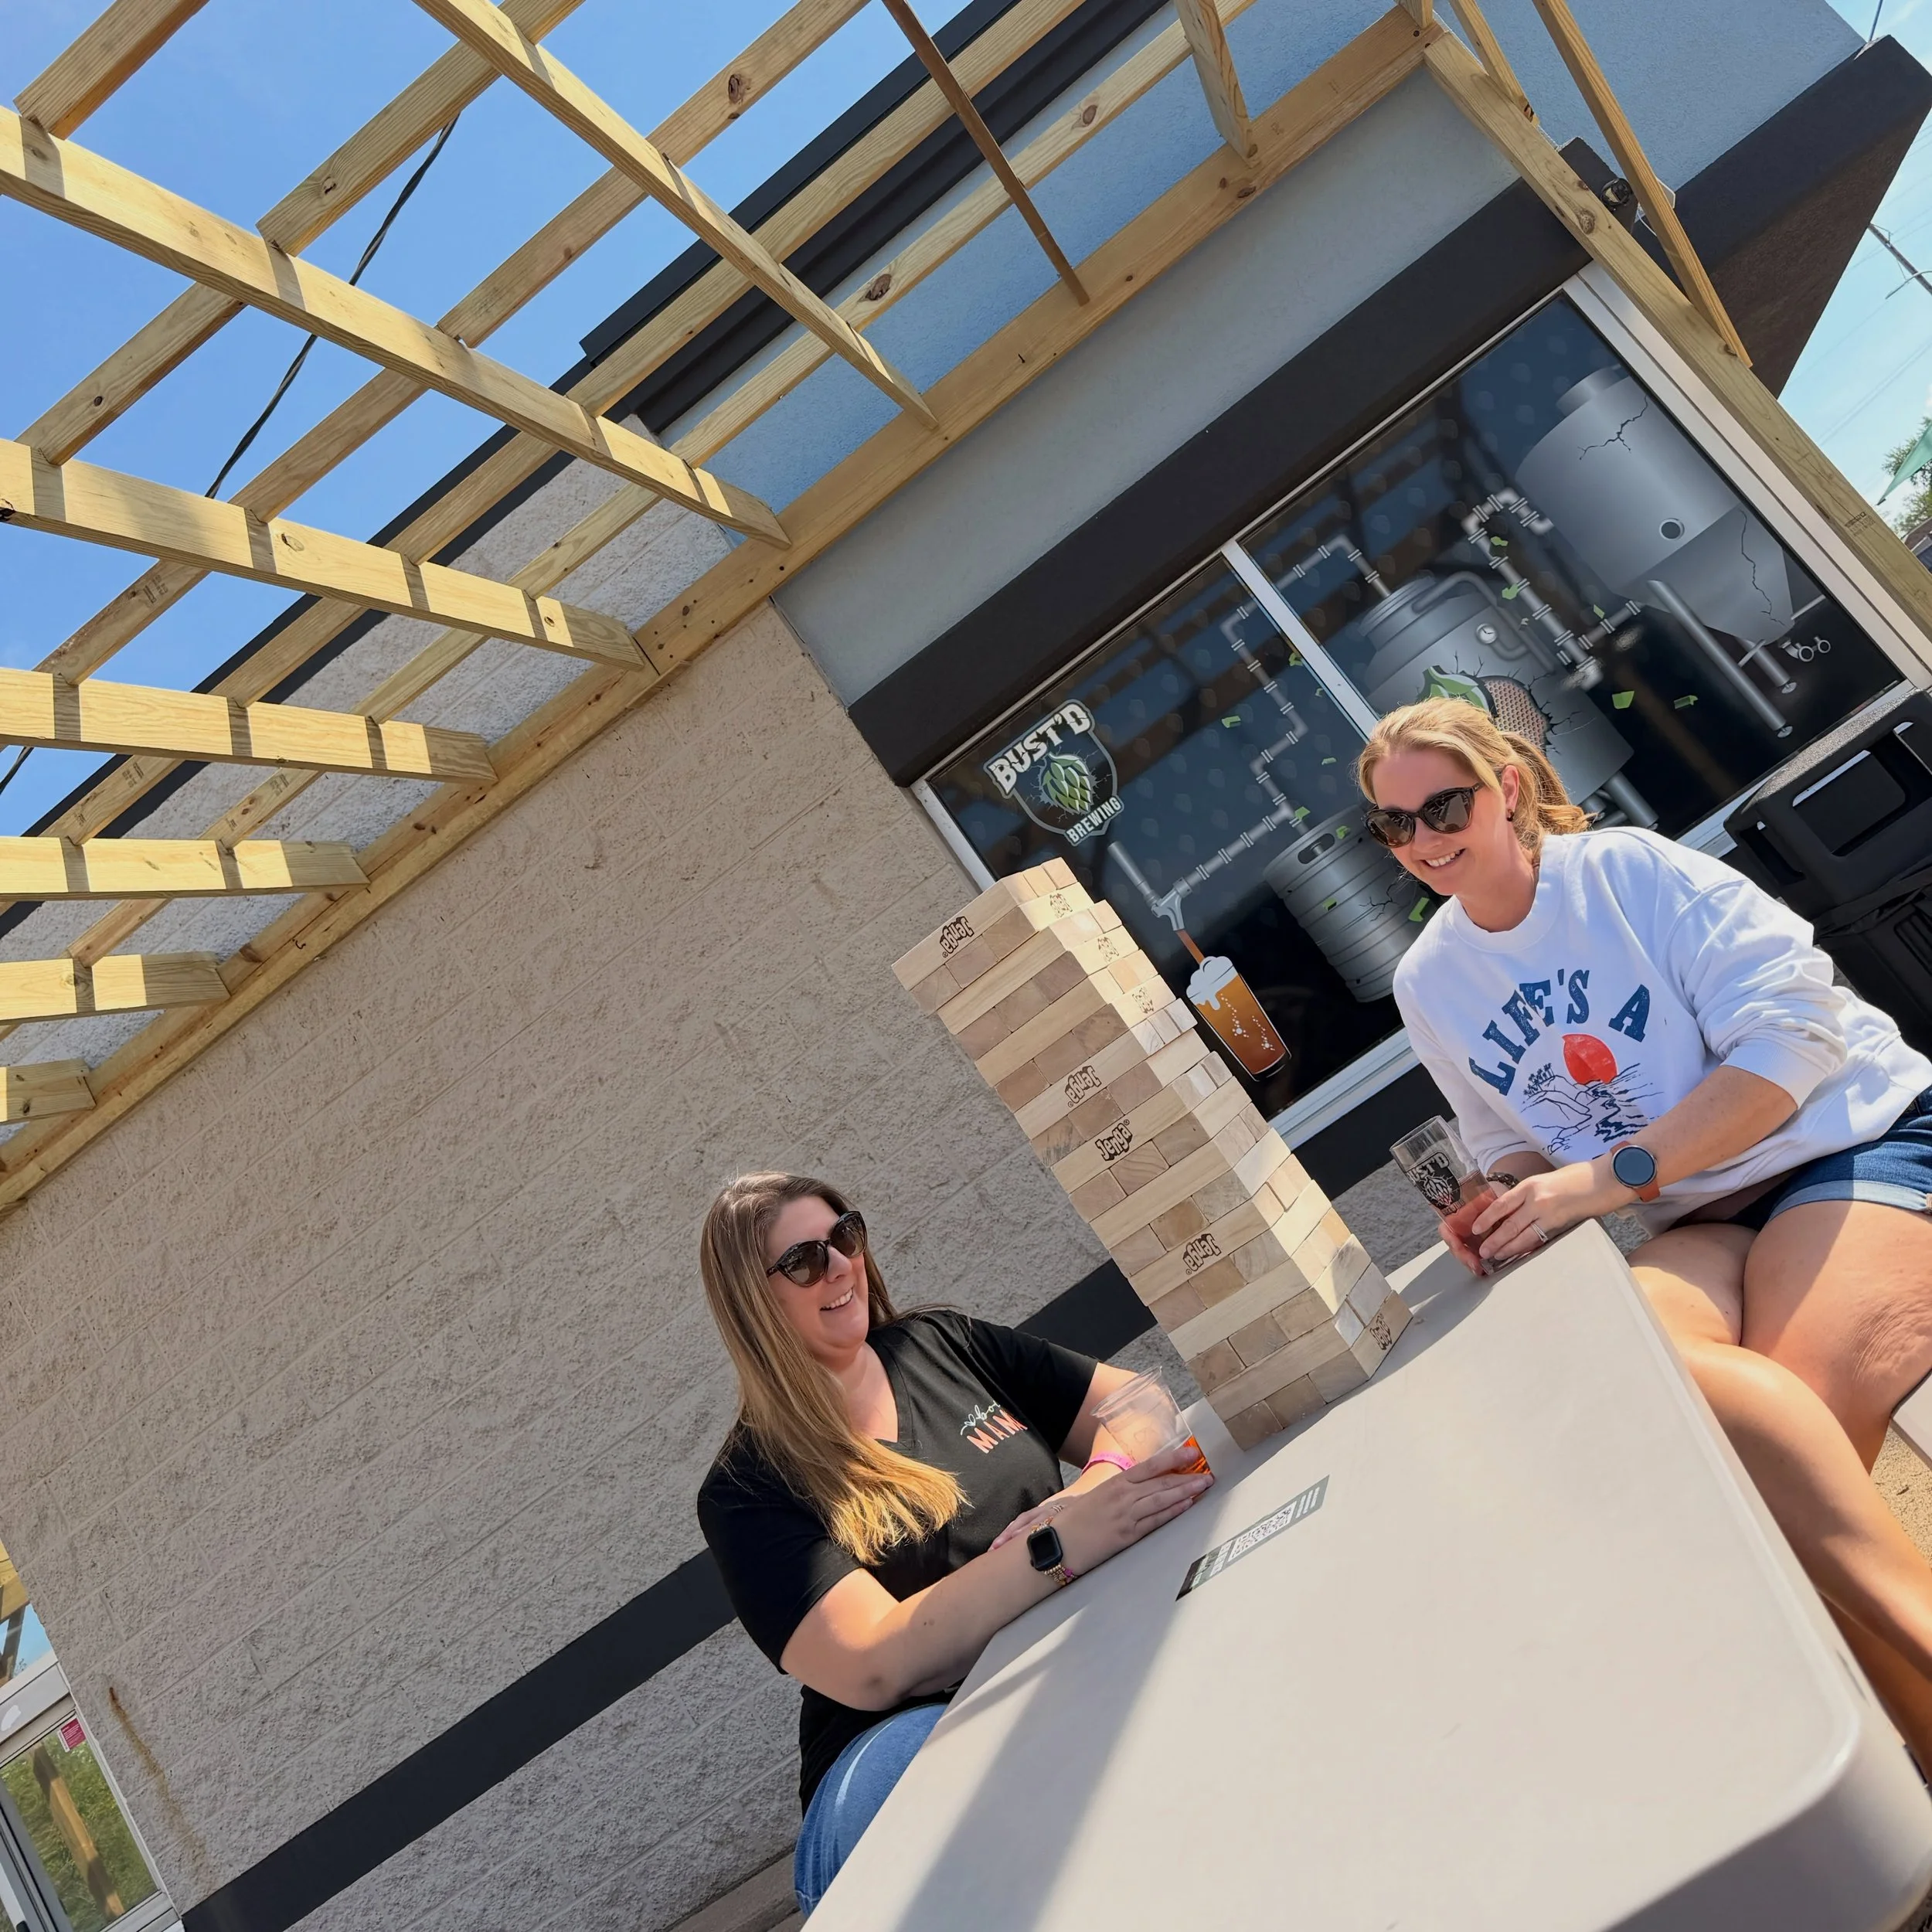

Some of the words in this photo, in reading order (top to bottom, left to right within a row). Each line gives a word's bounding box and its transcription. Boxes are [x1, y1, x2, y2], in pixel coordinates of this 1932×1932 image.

[988, 702, 1091, 794] BUST'D
[1066, 797, 1121, 843] BREWING
[940, 916, 975, 955] Jenga
[1468, 968, 1590, 1097] LIFE'S
[1608, 984, 1651, 1043] A
[1064, 1065, 1102, 1105] Jenga
[1095, 1122, 1133, 1161] Jenga
[1183, 1233, 1222, 1273] Jenga
